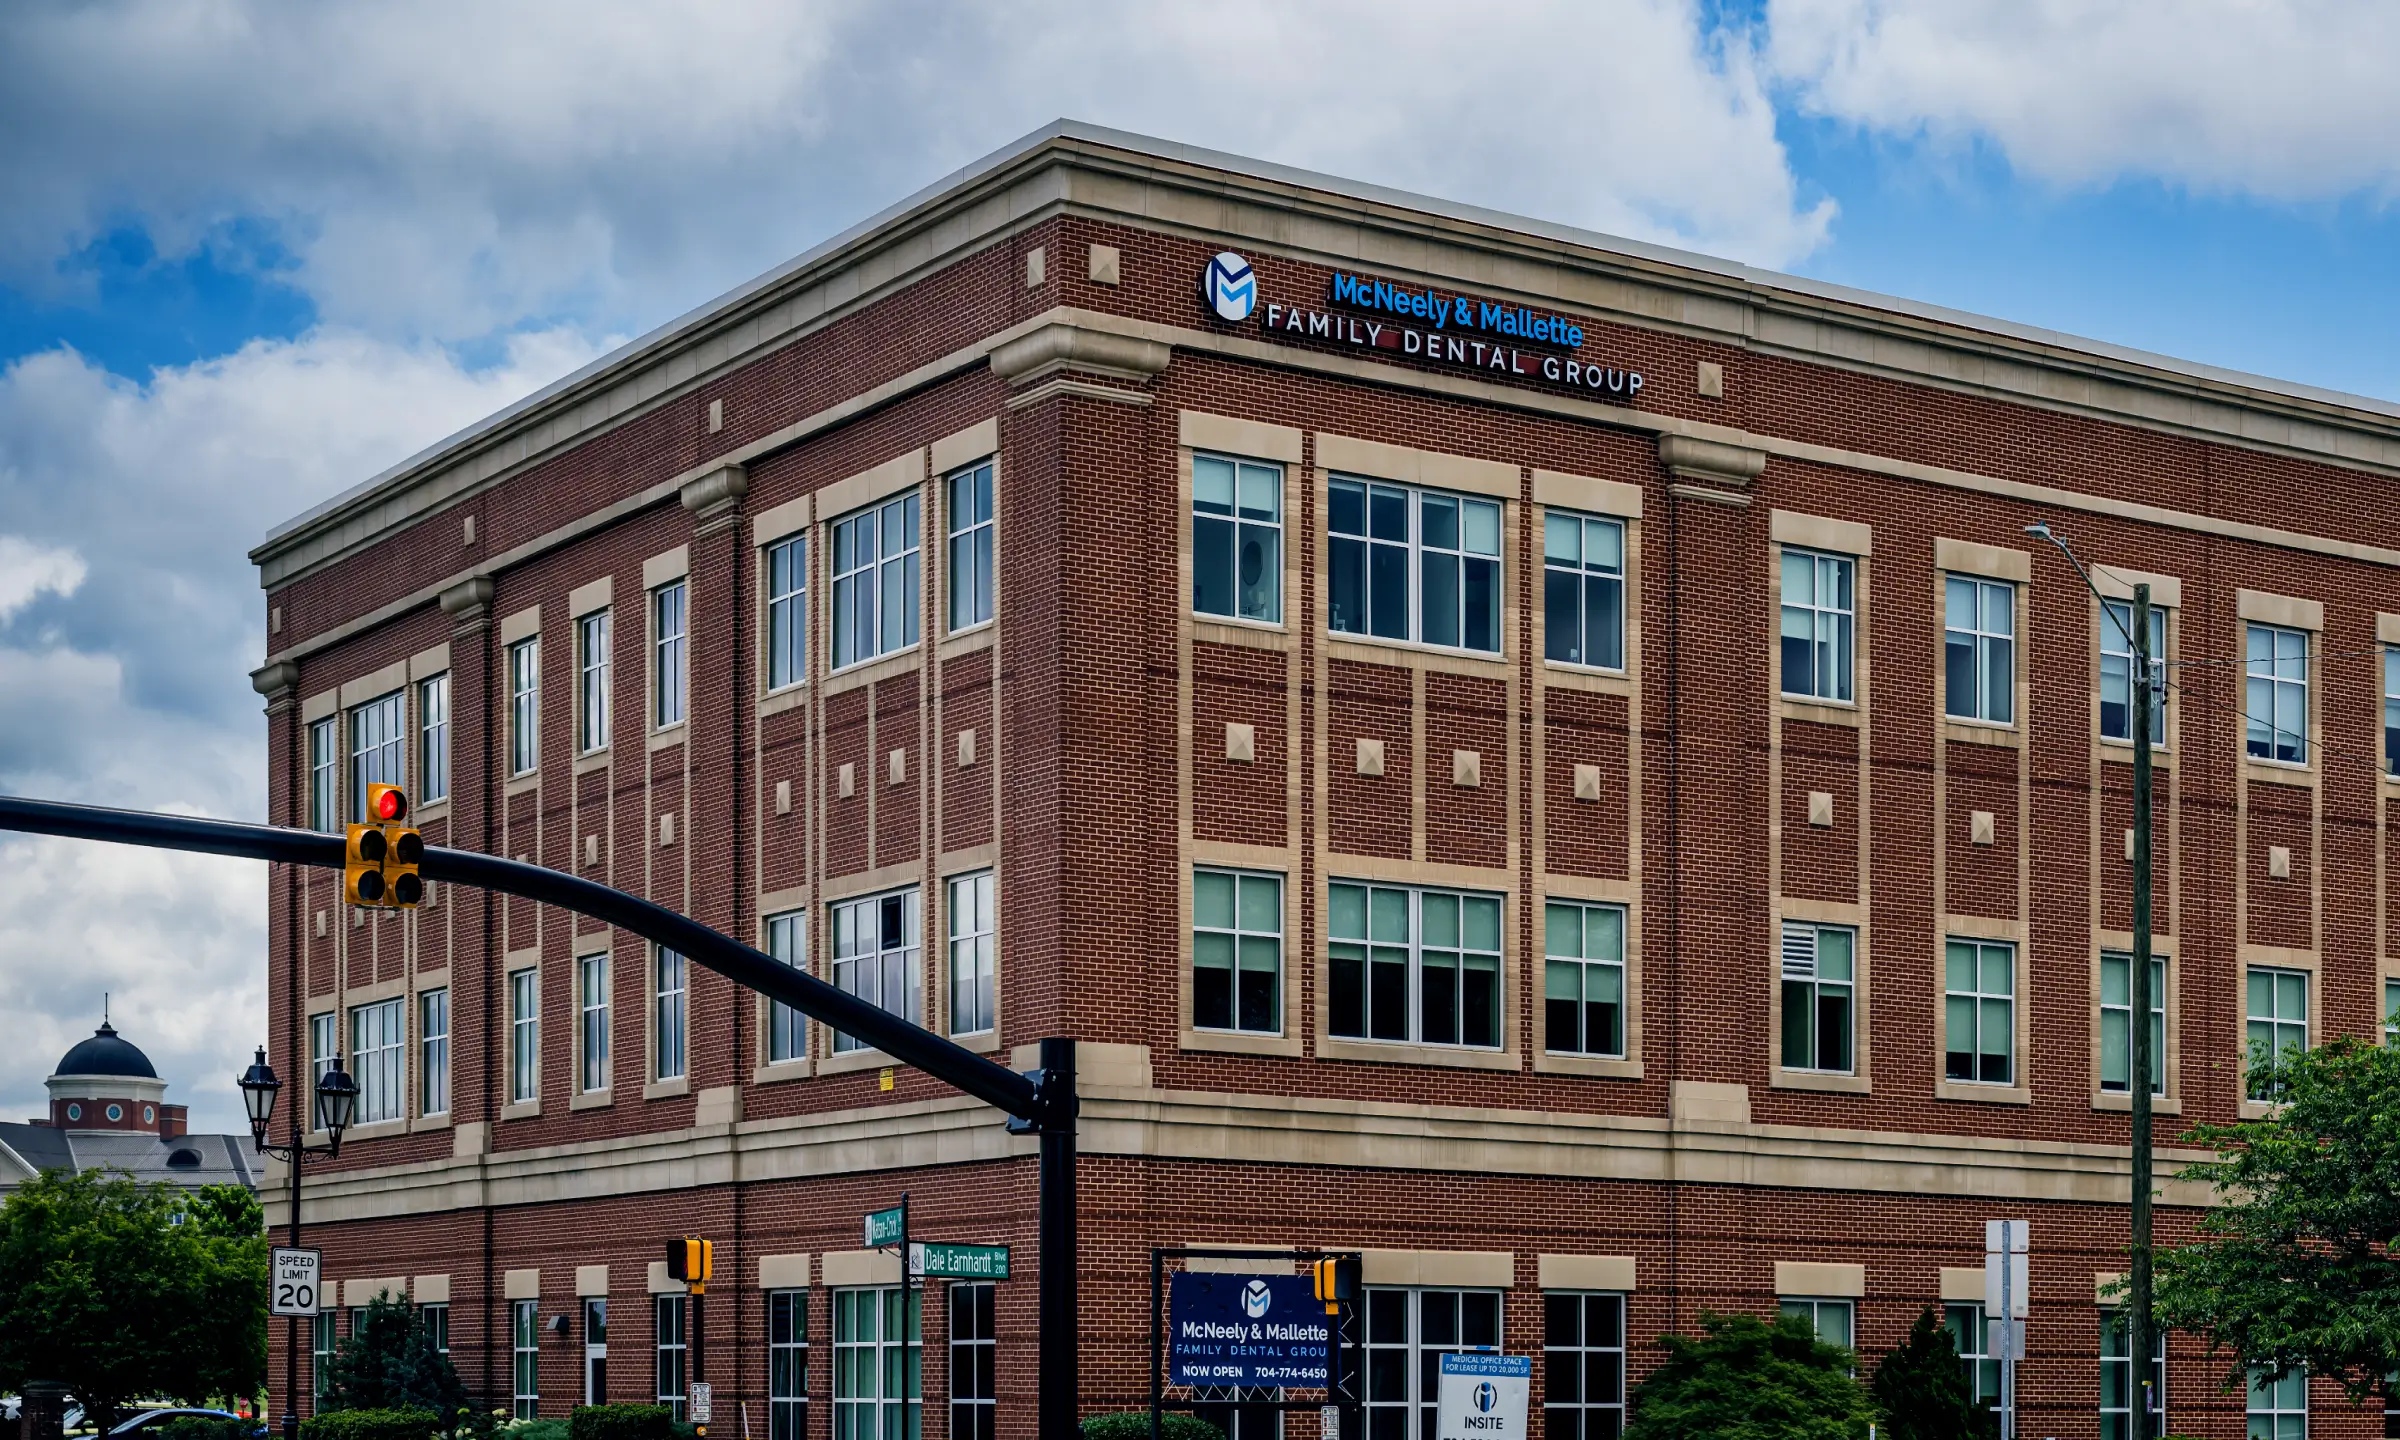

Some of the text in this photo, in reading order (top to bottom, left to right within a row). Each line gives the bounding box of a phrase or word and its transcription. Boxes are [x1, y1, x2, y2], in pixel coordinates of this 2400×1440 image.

[1335, 272, 1583, 348] McNeely & Mallette
[1268, 304, 1643, 396] FAMILY DENTAL GROUP
[279, 1256, 314, 1267] SPEED
[926, 1249, 1006, 1273] Dale Earnhardt Blvd
[283, 1269, 309, 1280] LIMIT
[995, 1264, 1006, 1274] 200
[278, 1284, 313, 1308] 20
[1182, 1321, 1328, 1343] McNeely & Mallette
[1176, 1344, 1327, 1357] FAMILY DENTAL GROU
[1182, 1366, 1328, 1378] NOW OPEN 704-774-6450
[1499, 1366, 1519, 1374] 20,000
[1464, 1416, 1503, 1429] INSITE
